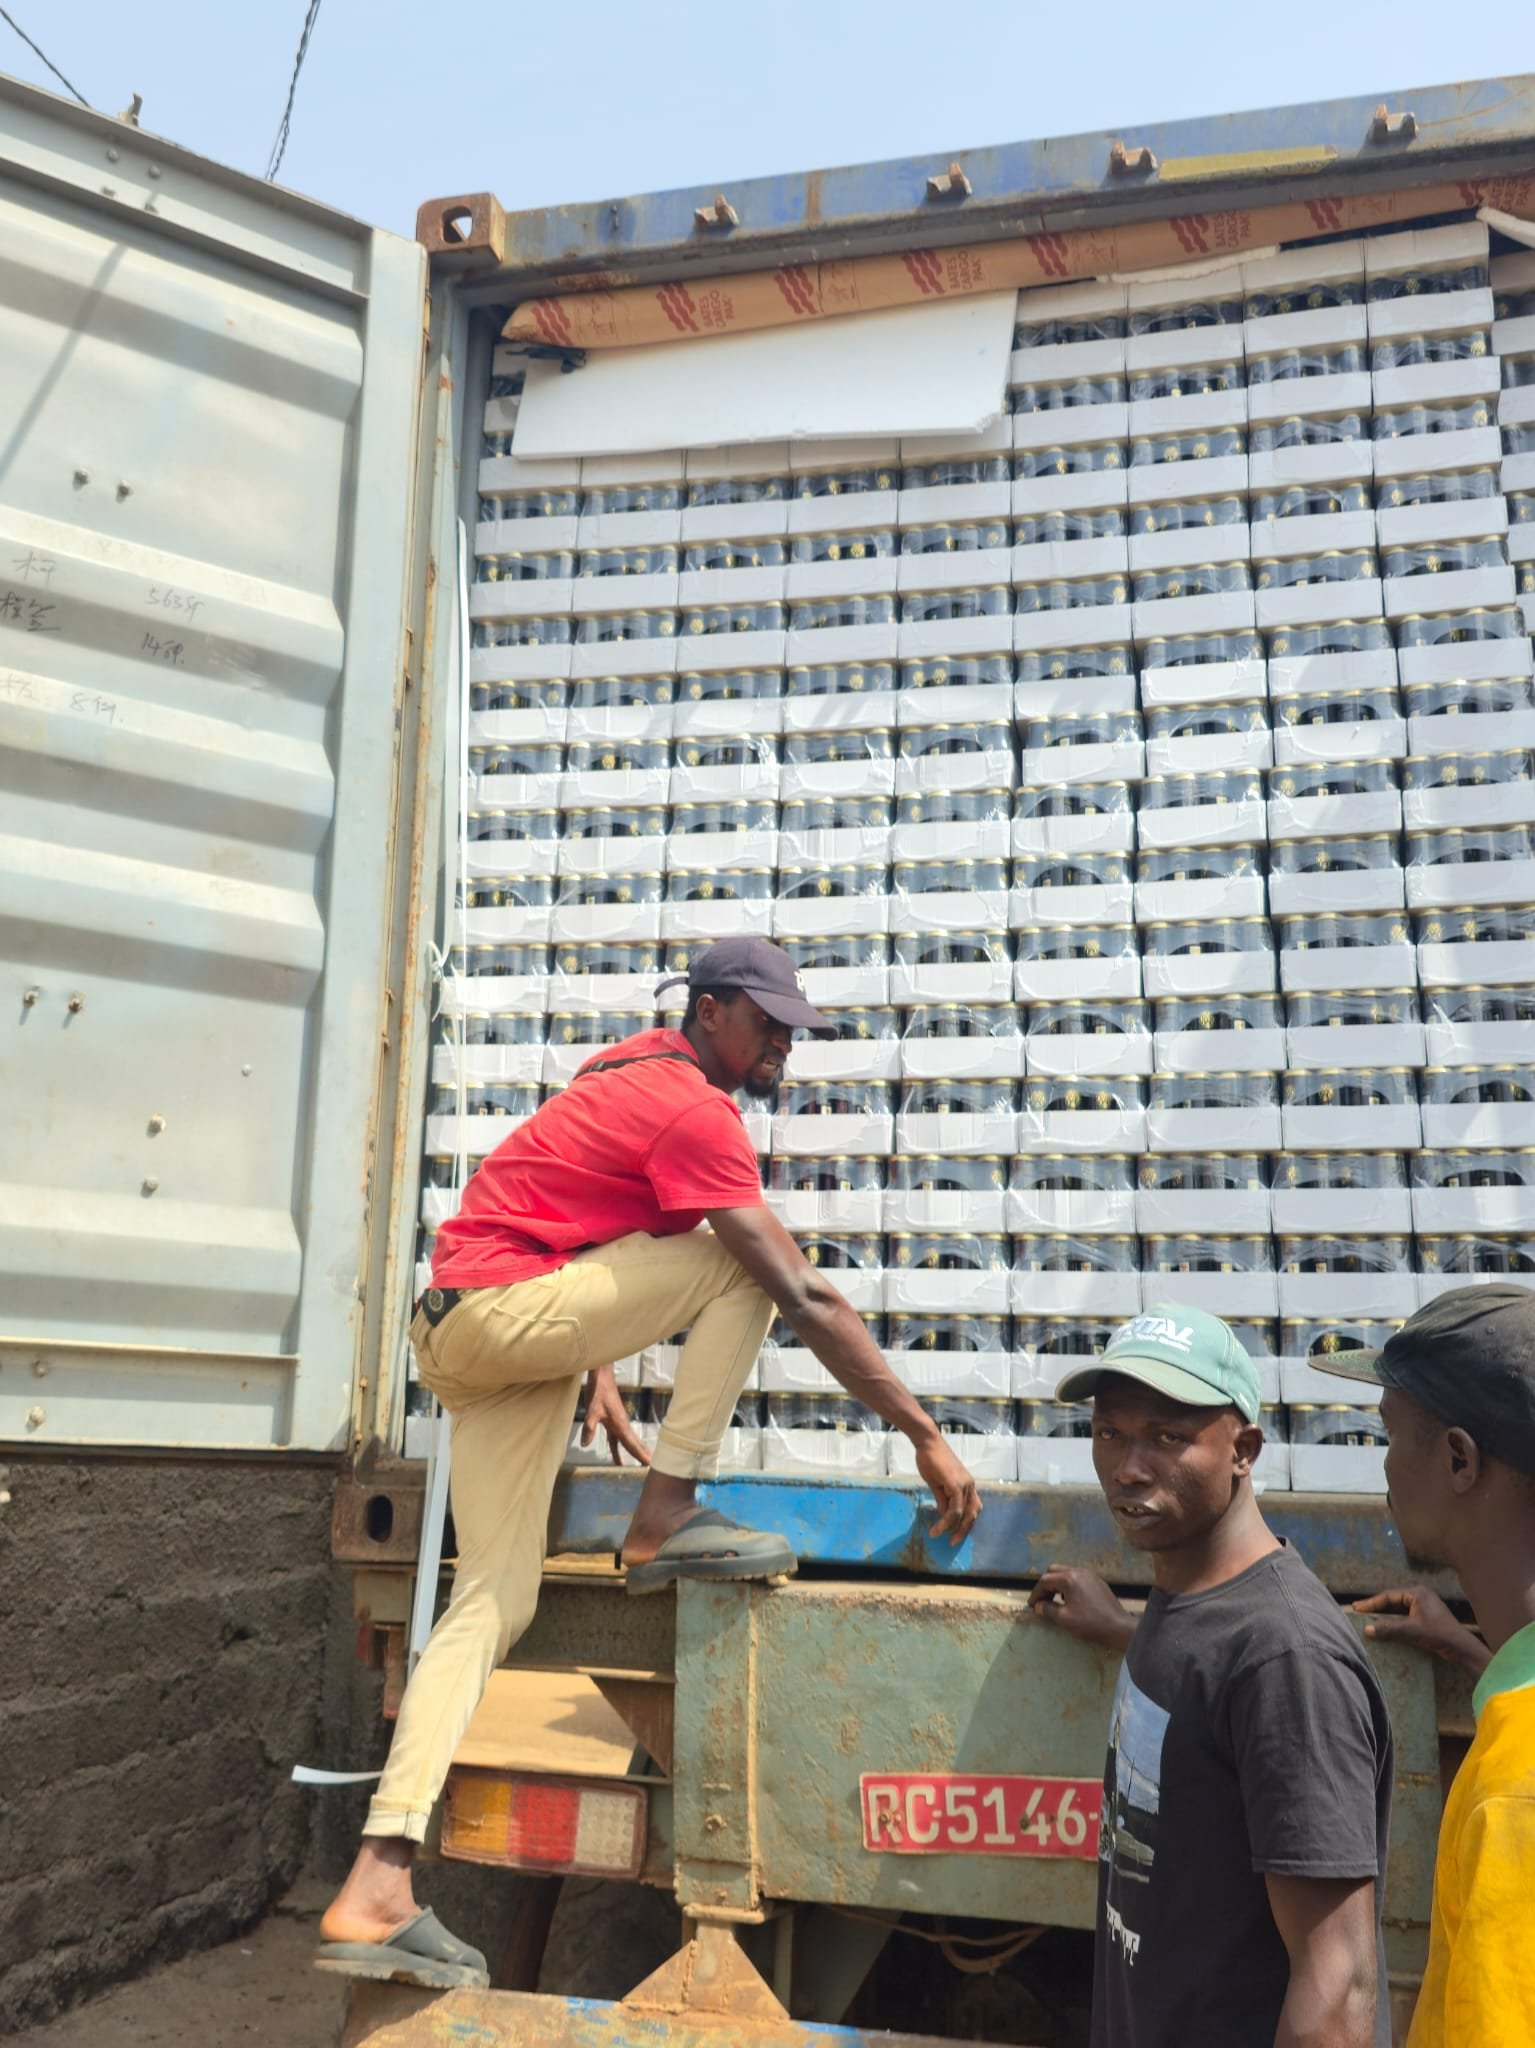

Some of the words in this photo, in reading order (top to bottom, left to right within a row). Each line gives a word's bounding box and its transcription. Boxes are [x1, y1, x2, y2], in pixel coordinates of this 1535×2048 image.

[946, 255, 960, 289] BATES
[958, 249, 973, 289] CARGO
[699, 296, 714, 328] BATES
[710, 289, 727, 329] CARGO
[722, 293, 735, 320] PAK
